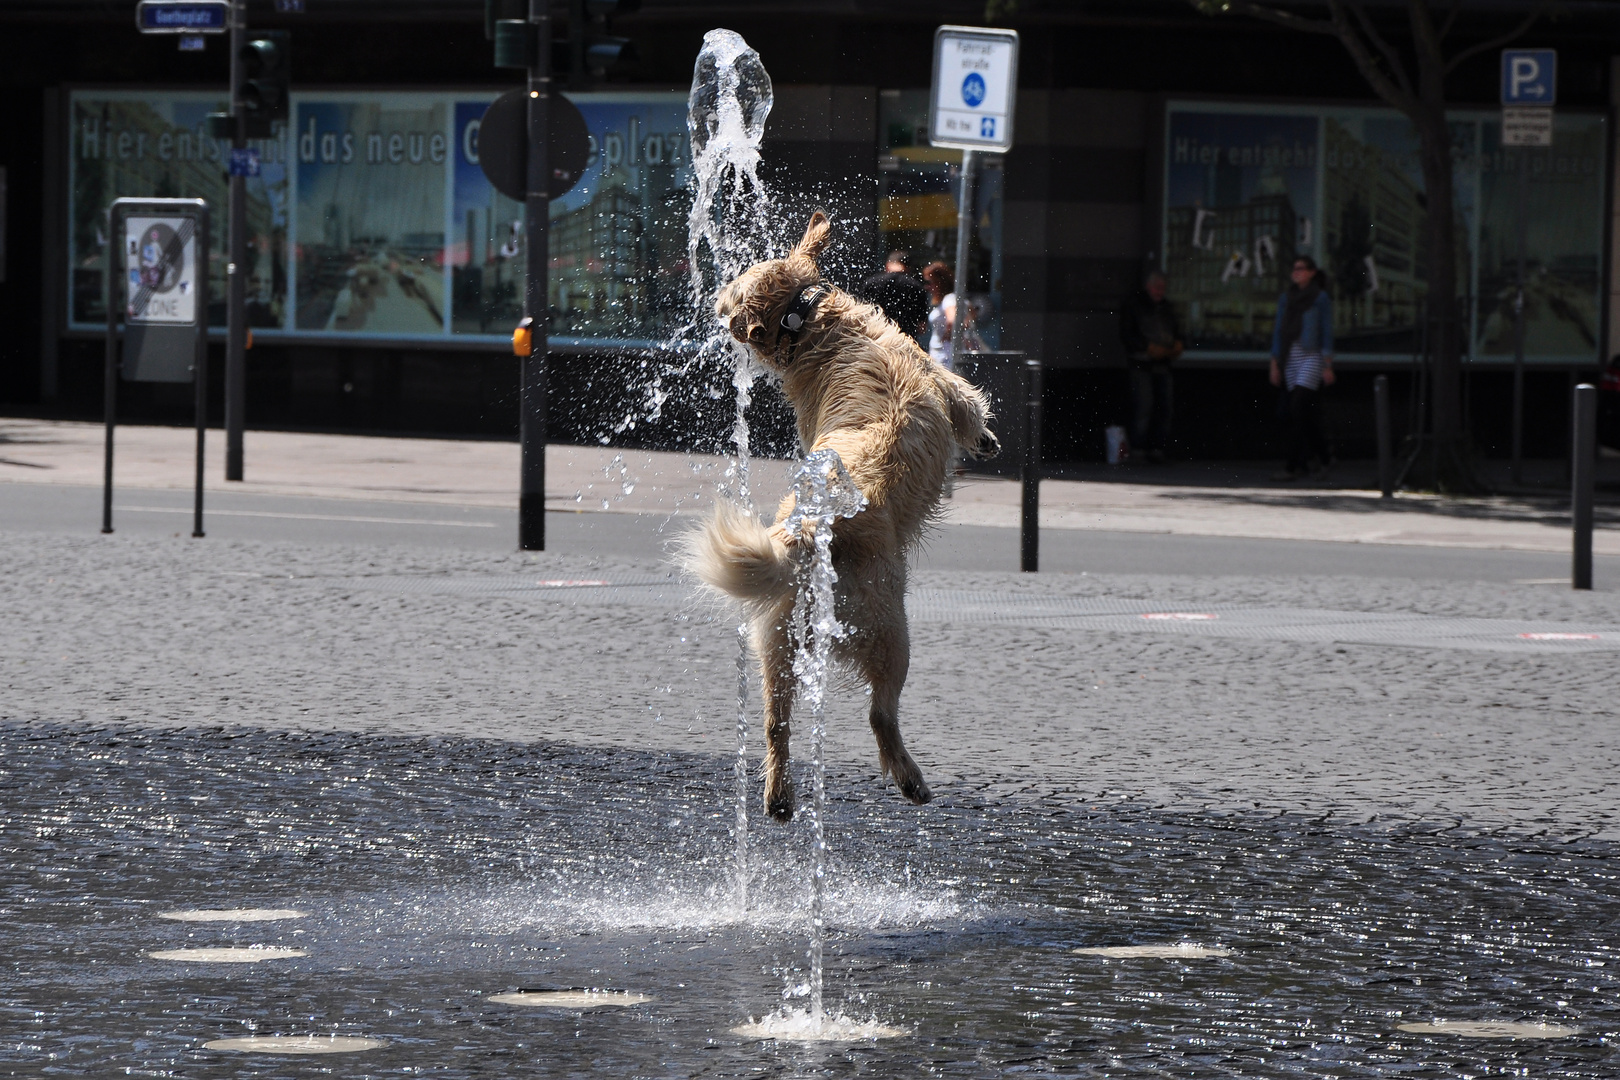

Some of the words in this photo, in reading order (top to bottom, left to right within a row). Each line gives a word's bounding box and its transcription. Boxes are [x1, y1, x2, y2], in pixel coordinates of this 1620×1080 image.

[1511, 57, 1540, 98] P
[81, 118, 147, 160] Hier
[301, 115, 353, 164] das
[367, 132, 444, 164] neue
[1175, 136, 1220, 164] Hier
